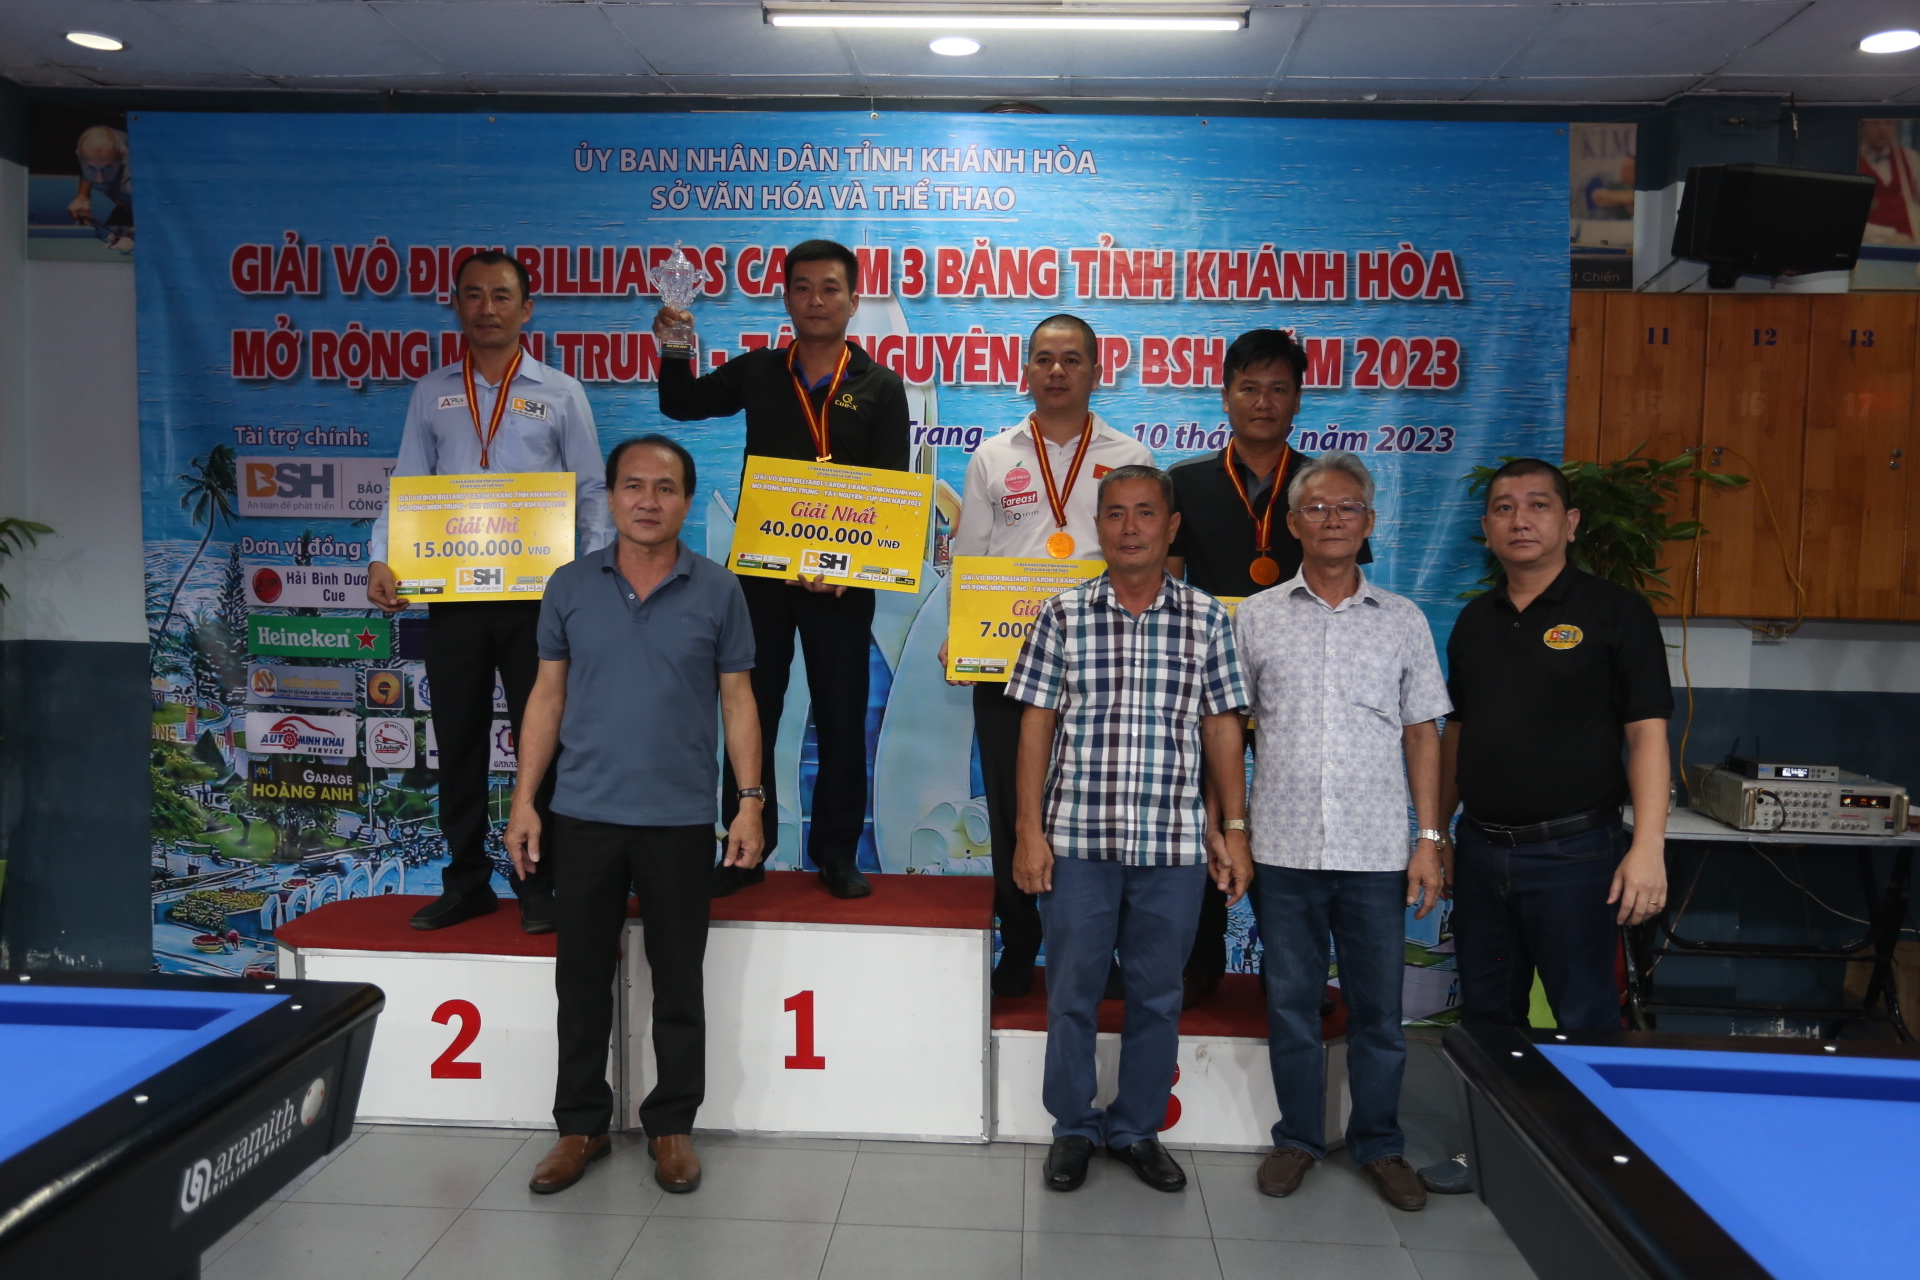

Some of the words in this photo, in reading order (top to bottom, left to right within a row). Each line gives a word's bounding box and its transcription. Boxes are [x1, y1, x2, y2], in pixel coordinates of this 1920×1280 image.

[574, 141, 614, 172] ỦY
[619, 148, 679, 172] BAN
[686, 143, 769, 172] NHÂN
[777, 143, 839, 172] DÂN
[844, 140, 914, 172] TỈNH
[921, 144, 1025, 173] KHÁNH
[1033, 145, 1098, 174] HÒA
[651, 180, 691, 210] SỞ
[694, 181, 754, 210] VĂN
[761, 181, 825, 210] HÓA
[829, 181, 869, 210] VÀ
[873, 178, 930, 210] THỂ
[934, 186, 1016, 211] THAO
[231, 230, 321, 295] GIẢI
[333, 236, 400, 295] VÔ
[408, 245, 507, 305] ĐỊC
[735, 246, 891, 298] CAM
[901, 247, 926, 298] 3
[935, 236, 1058, 298] BĂNG
[1069, 232, 1175, 299] TỈNH
[1185, 242, 1347, 300] KHÁNH
[1356, 241, 1464, 300] HÒA
[1647, 327, 1670, 345] 11
[1752, 328, 1778, 346] 12
[1848, 330, 1875, 348] 13
[231, 313, 302, 379] MỞ
[310, 321, 430, 389] RỘNG
[439, 329, 546, 378] MN
[555, 331, 699, 384] TRUN
[1139, 335, 1227, 388] BSH
[1353, 336, 1461, 389] 2023
[514, 398, 546, 416] BSH
[233, 425, 264, 446] Tài
[267, 427, 301, 451] trợ
[304, 426, 370, 447] chính:
[1133, 422, 1170, 450] 10
[1299, 423, 1370, 451] năm
[1374, 424, 1456, 454] 2023
[246, 462, 335, 499] BSH
[357, 481, 383, 494] BẢO
[348, 498, 383, 510] CÔNG
[1003, 493, 1036, 508] Fareast
[790, 501, 829, 519] Giải
[831, 505, 878, 525] Nhất
[445, 517, 481, 535] Giải
[486, 516, 520, 534] Nhì
[760, 519, 873, 546] 40.000.000
[877, 538, 901, 549] VNĐ
[241, 536, 280, 555] Đơn
[284, 537, 302, 560] vị
[306, 535, 361, 561] đồng
[413, 540, 523, 558] 15.000.000
[528, 546, 551, 555] VNĐ
[803, 551, 848, 571] BSH
[286, 570, 307, 585] Hải
[312, 571, 339, 586] Bình
[344, 573, 370, 586] Dươ
[459, 569, 501, 586] BSH
[323, 589, 346, 602] Cue
[1011, 599, 1042, 616] Giả
[257, 626, 350, 648] Heineken
[299, 736, 321, 745] MINH
[322, 737, 345, 747] KHAI
[252, 781, 316, 799] HOÀNG
[320, 787, 354, 801] ANH
[431, 999, 482, 1078] 2
[784, 990, 826, 1069] 1
[214, 1099, 294, 1179] aramith
[212, 1155, 260, 1195] BILLIARD
[264, 1128, 292, 1157] BALLS
